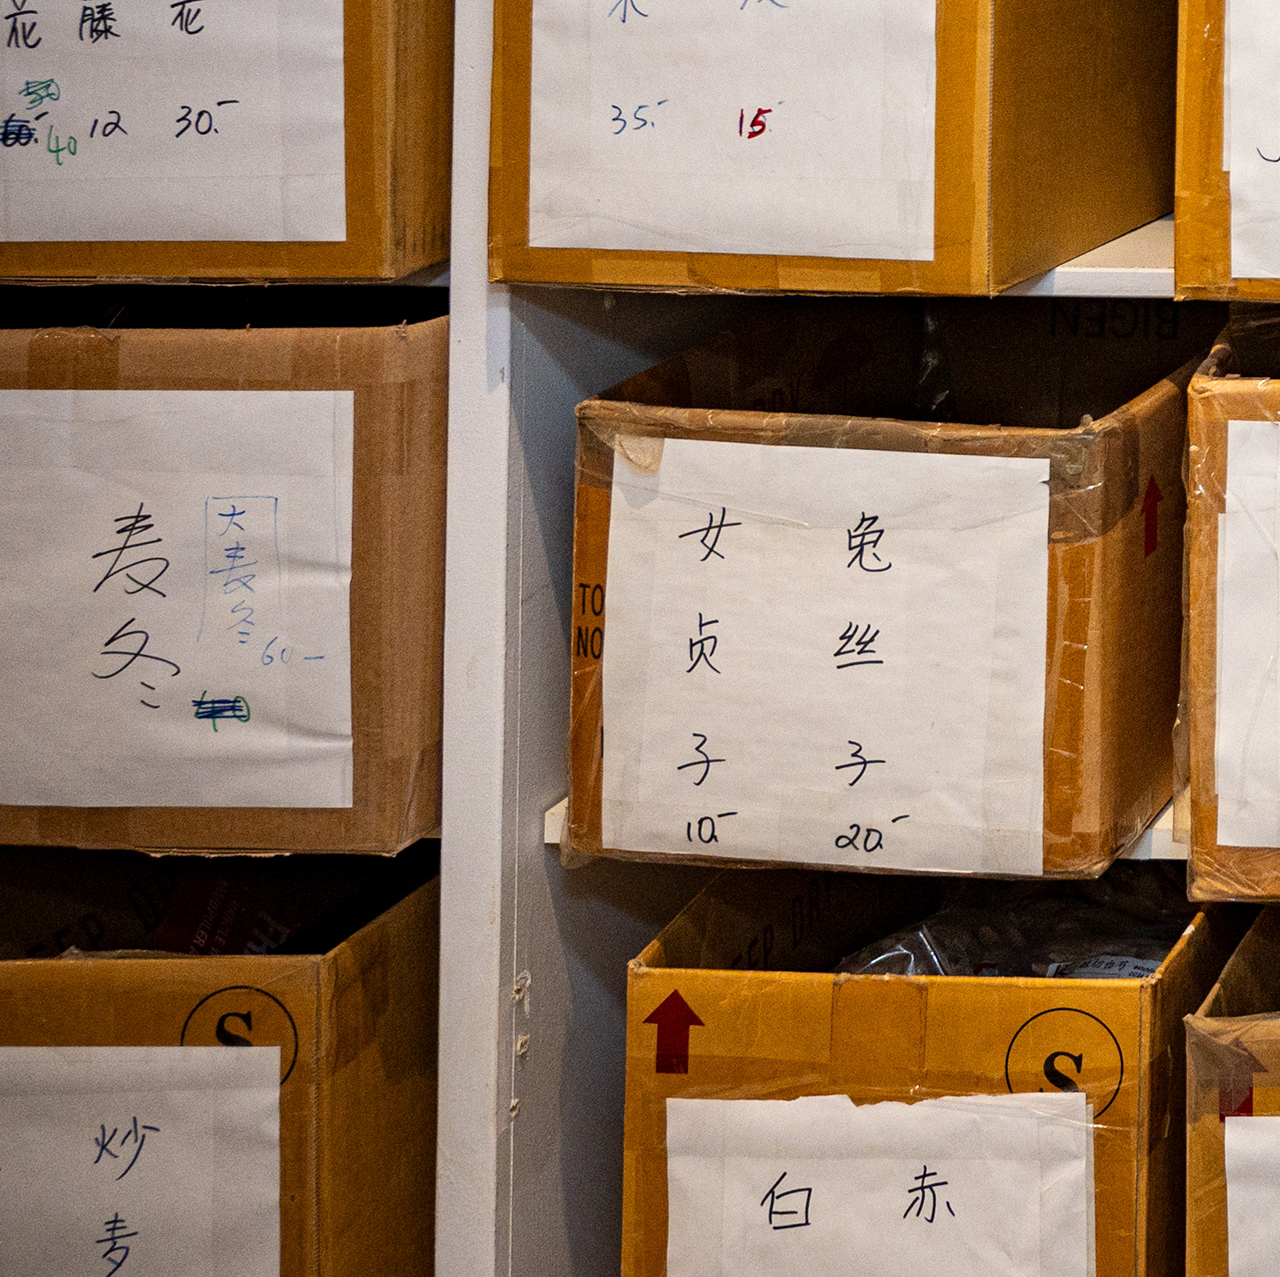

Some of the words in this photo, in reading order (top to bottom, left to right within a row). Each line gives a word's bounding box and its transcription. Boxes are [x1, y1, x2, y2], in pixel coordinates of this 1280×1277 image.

[88, 109, 128, 139] 12
[675, 505, 743, 788] 女贞子
[832, 510, 893, 789] 兔丝子
[759, 1170, 814, 1232] 白
[902, 1164, 956, 1225] 赤
